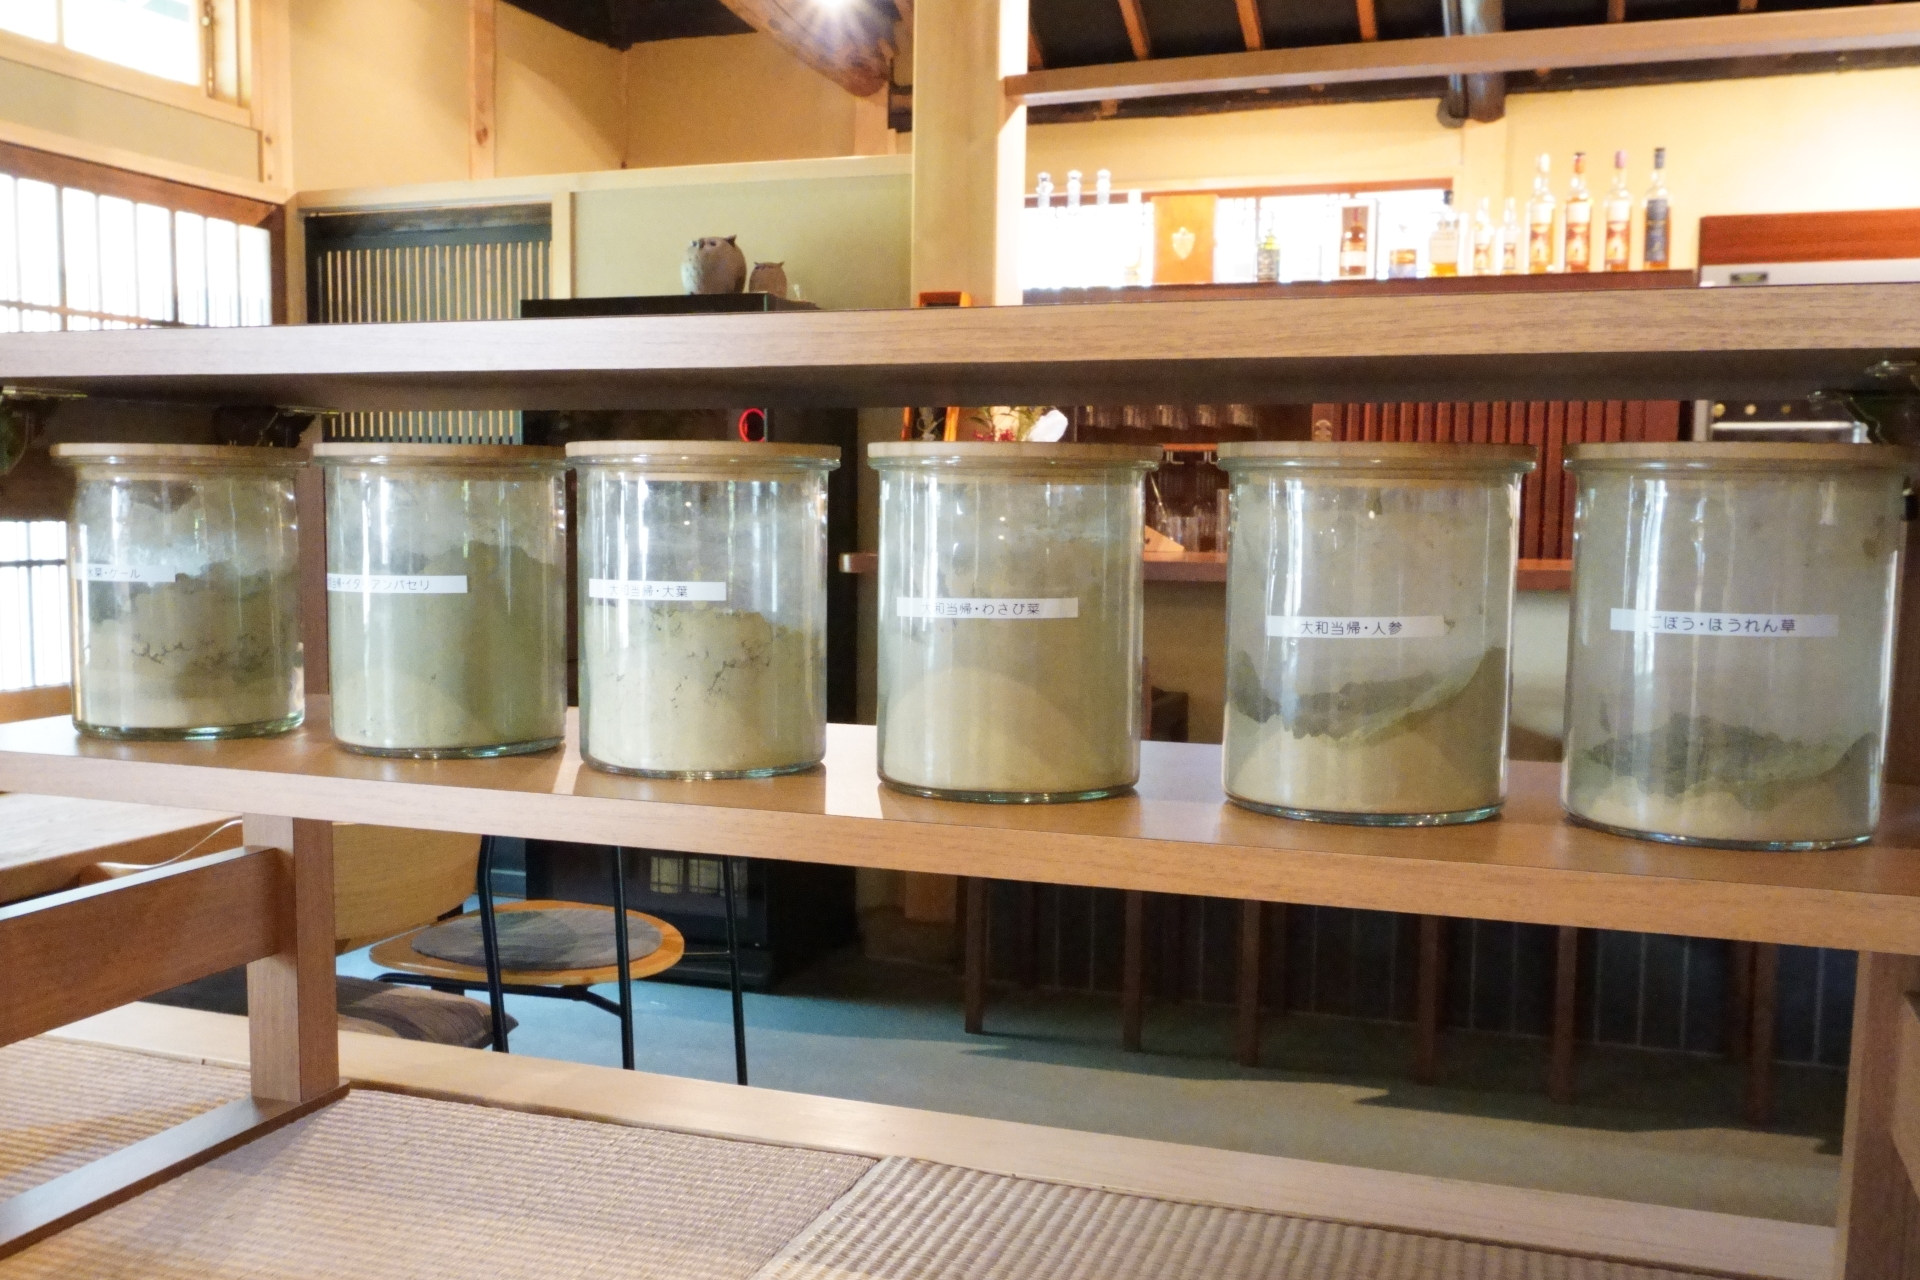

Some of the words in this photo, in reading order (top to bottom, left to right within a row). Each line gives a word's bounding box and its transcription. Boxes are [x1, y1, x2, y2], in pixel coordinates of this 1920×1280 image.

[328, 576, 430, 591] 当帰・イタアンパセリ
[609, 585, 689, 598] 大和当帰・大葉
[921, 603, 1040, 616] 大和当帰・わさび菜
[1300, 620, 1403, 635] 大和当帰・人参
[1648, 615, 1797, 634] ごぼう・ほうれん草
